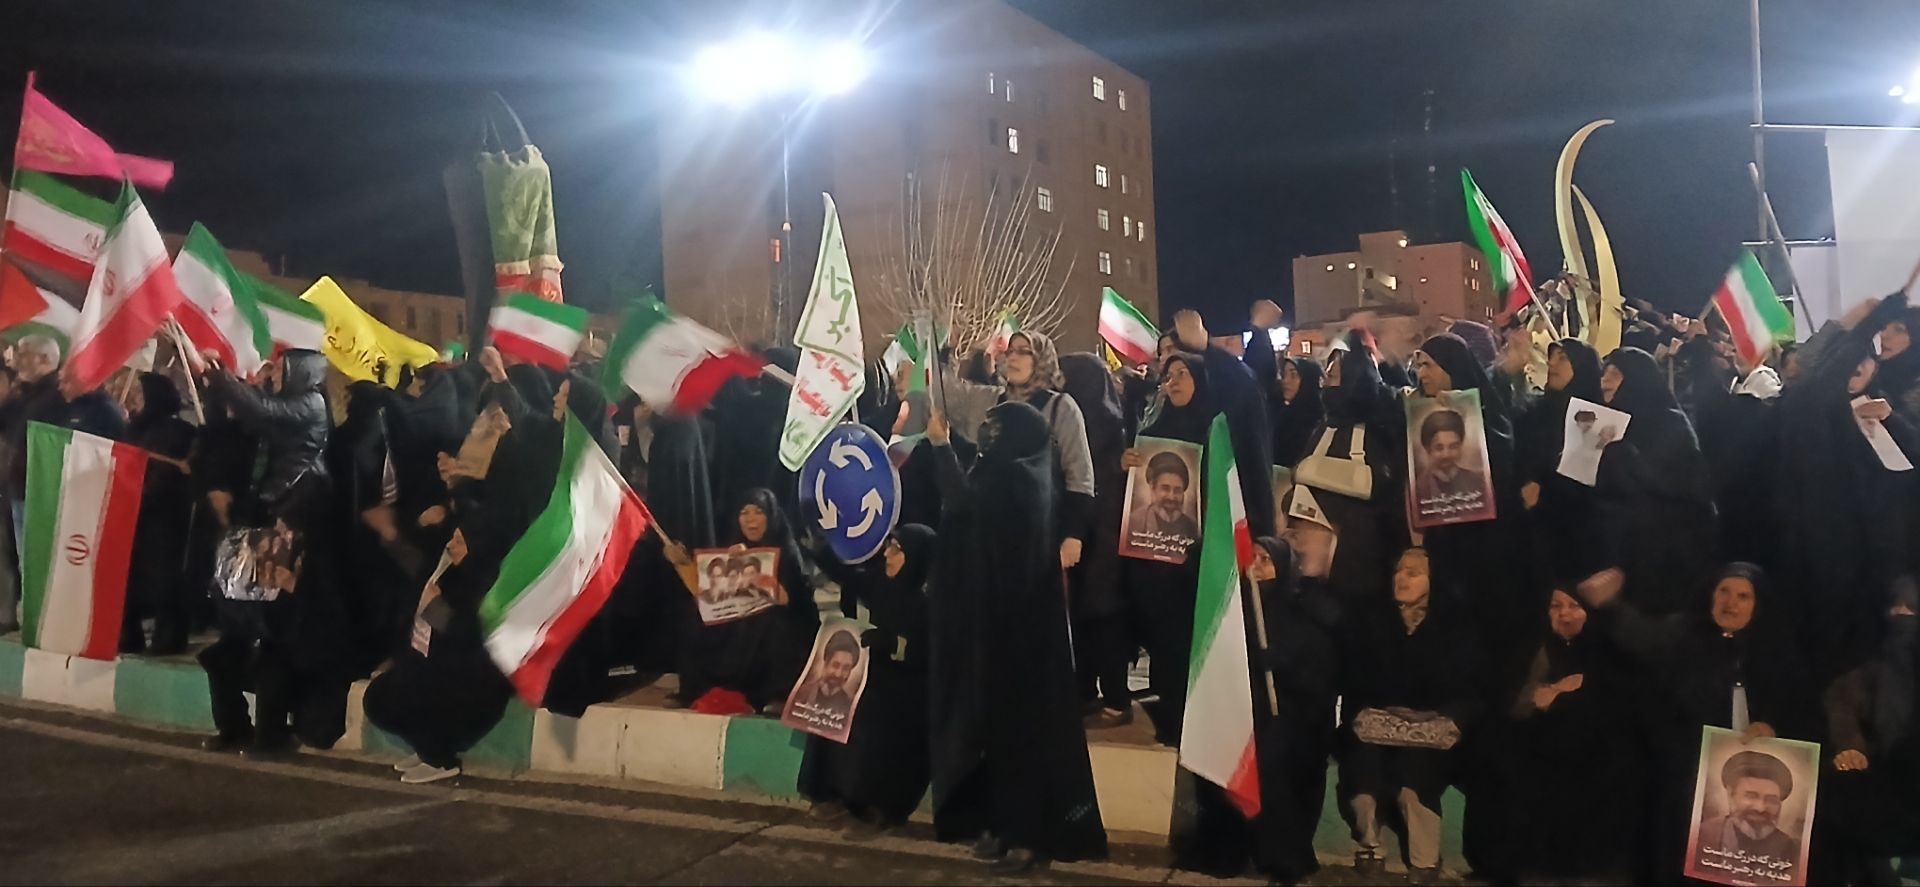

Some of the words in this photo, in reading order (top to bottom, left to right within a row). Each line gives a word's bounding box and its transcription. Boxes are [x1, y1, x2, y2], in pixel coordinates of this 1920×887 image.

[1703, 846, 1734, 858] ماست
[1701, 859, 1733, 871] ماست
[1757, 855, 1770, 864] که
[1768, 859, 1792, 870] خونی
[1732, 866, 1754, 877] رهبر
[1754, 868, 1766, 877] به
[1766, 869, 1792, 881] هدیه
